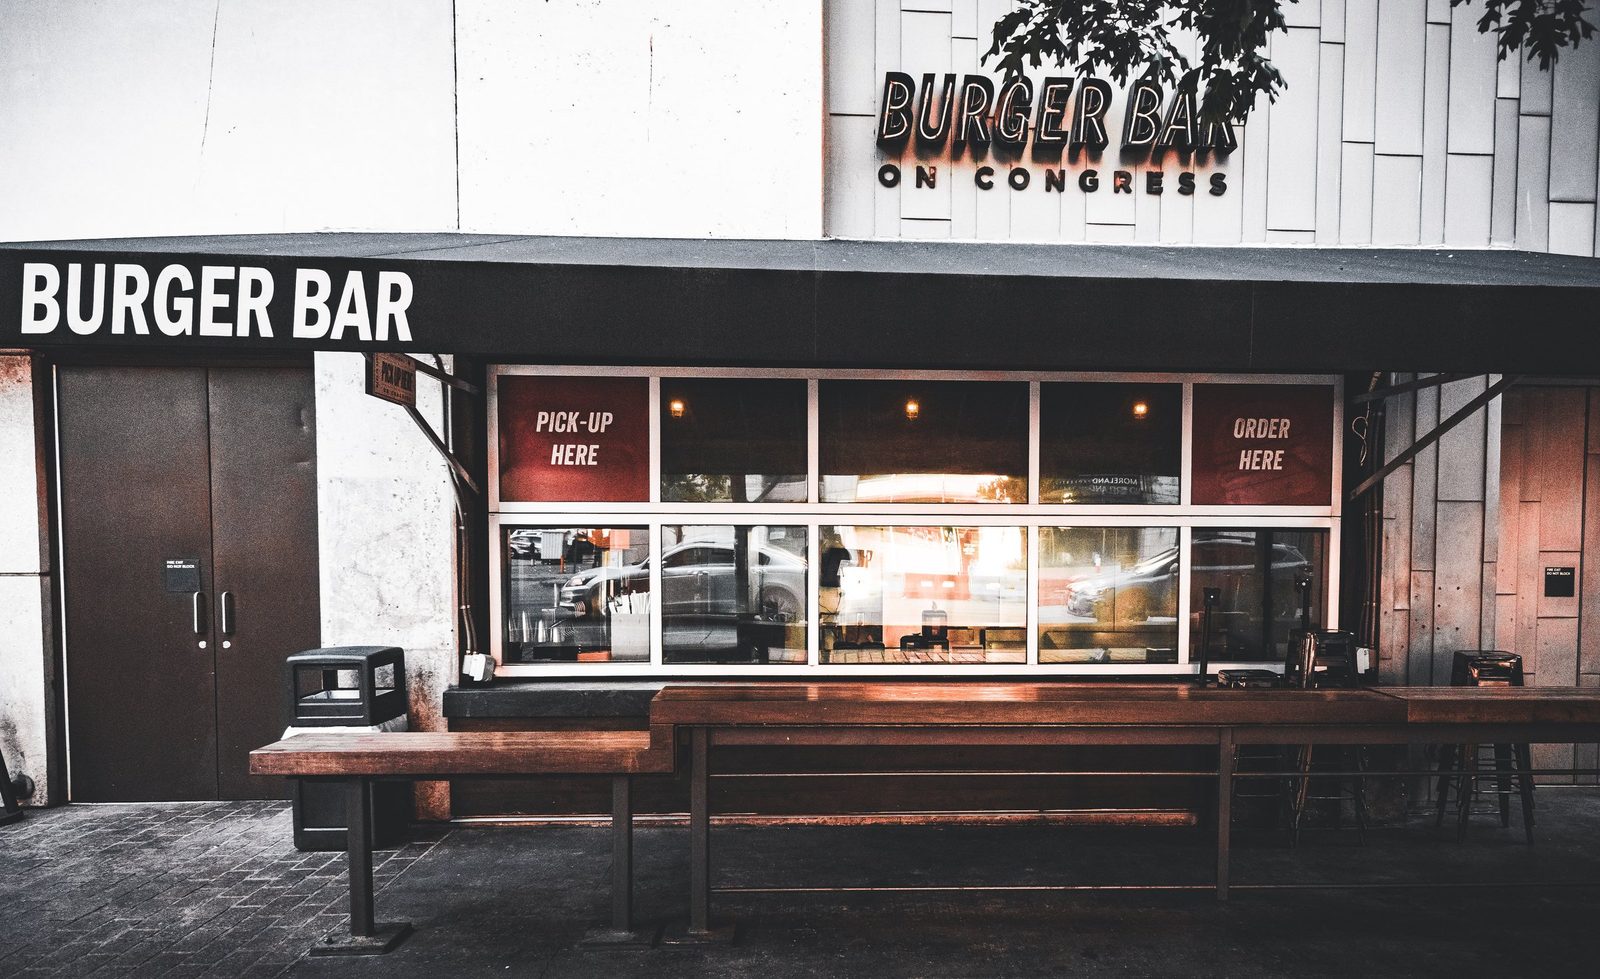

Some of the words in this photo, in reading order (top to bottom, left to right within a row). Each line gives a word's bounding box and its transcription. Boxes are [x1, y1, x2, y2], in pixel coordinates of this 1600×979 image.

[877, 71, 1112, 157] BURGER
[878, 164, 936, 189] ON
[974, 165, 1228, 197] CONGRESS
[20, 262, 275, 338] BURGER
[292, 267, 414, 342] BAR
[535, 411, 614, 433] PICK-UP
[1233, 417, 1291, 439] ORDER
[550, 444, 600, 466] HERE
[1239, 449, 1285, 470] HERE
